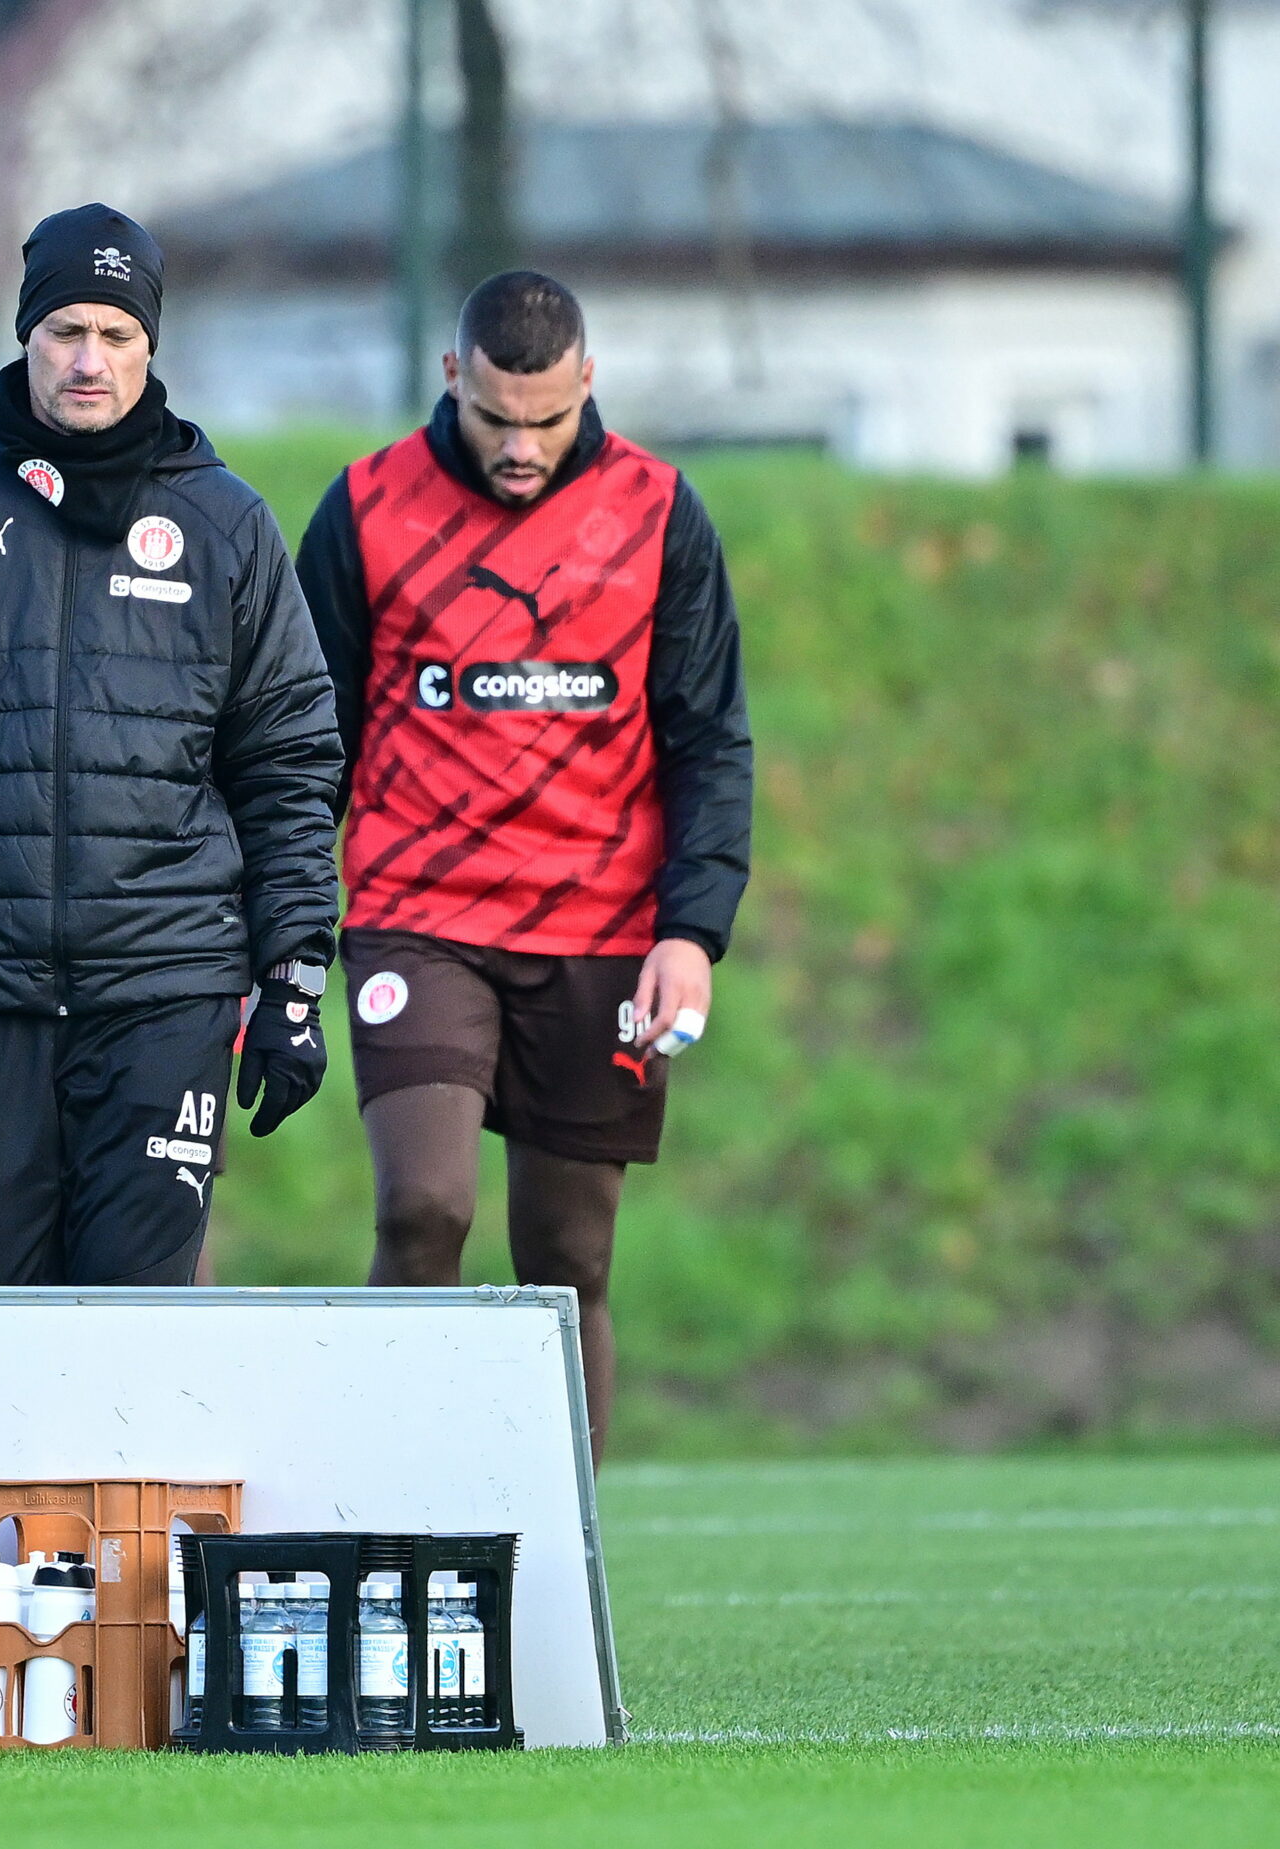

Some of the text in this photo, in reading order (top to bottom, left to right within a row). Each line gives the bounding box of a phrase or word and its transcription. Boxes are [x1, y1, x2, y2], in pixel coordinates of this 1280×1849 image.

[107, 269, 130, 282] PAULI
[32, 461, 60, 481] PAULI
[158, 519, 182, 545] PAULI
[136, 583, 186, 596] congstar
[472, 669, 605, 705] congstar
[174, 1090, 217, 1137] AB
[172, 1146, 209, 1159] congstar
[23, 1492, 85, 1505] Leihkasten
